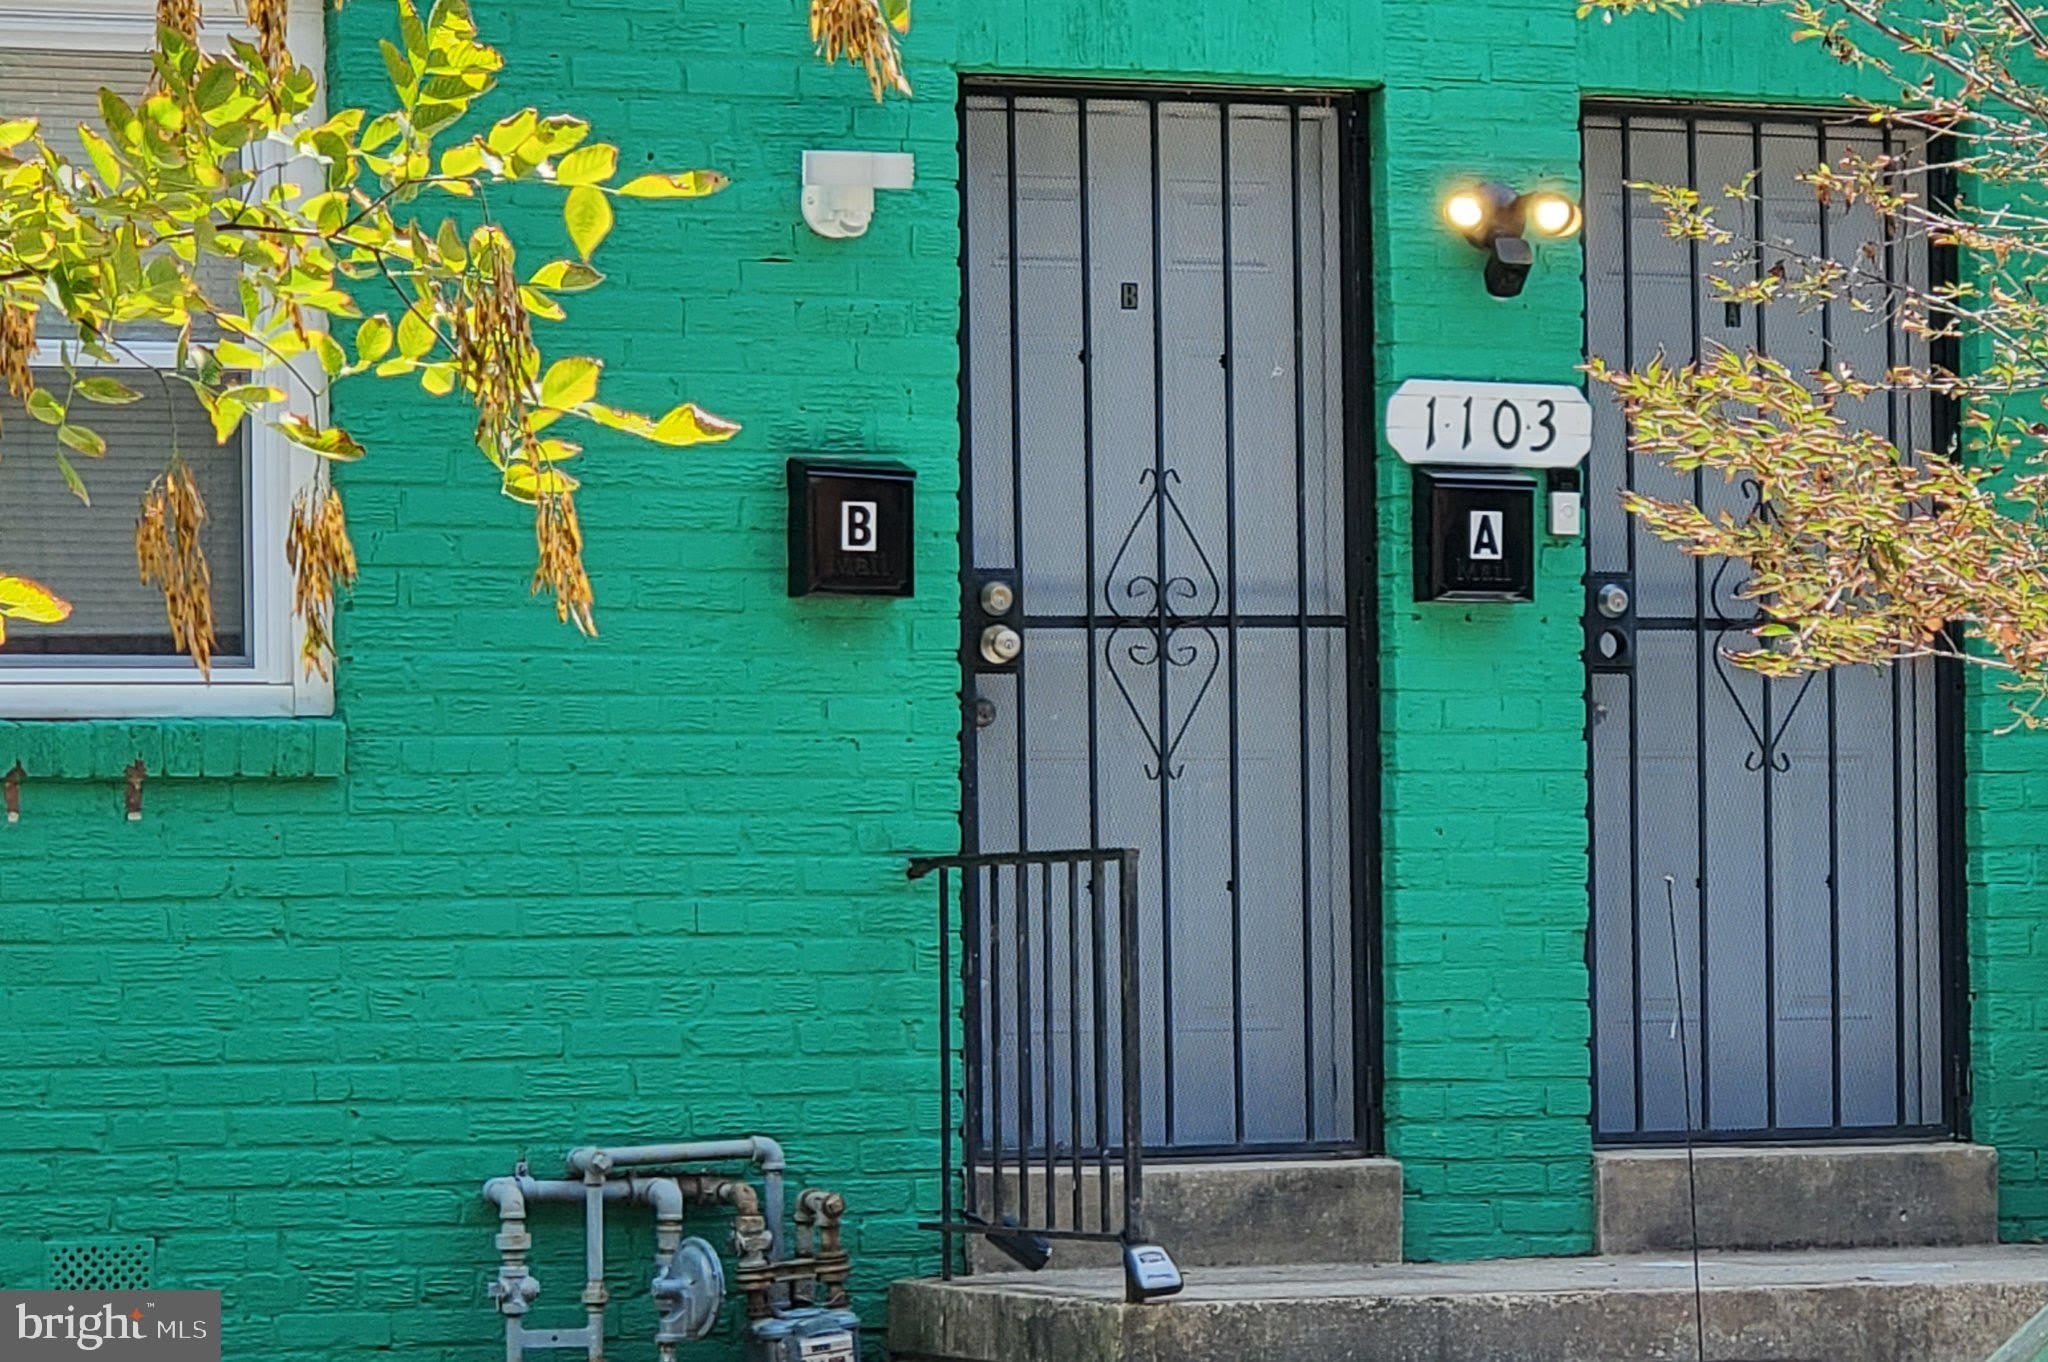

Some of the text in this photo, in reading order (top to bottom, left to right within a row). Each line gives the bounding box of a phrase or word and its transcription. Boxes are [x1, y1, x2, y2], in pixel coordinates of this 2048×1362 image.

[1123, 284, 1137, 308] B
[1426, 395, 1557, 452] 1103
[848, 505, 872, 546] B
[1473, 514, 1499, 555] A
